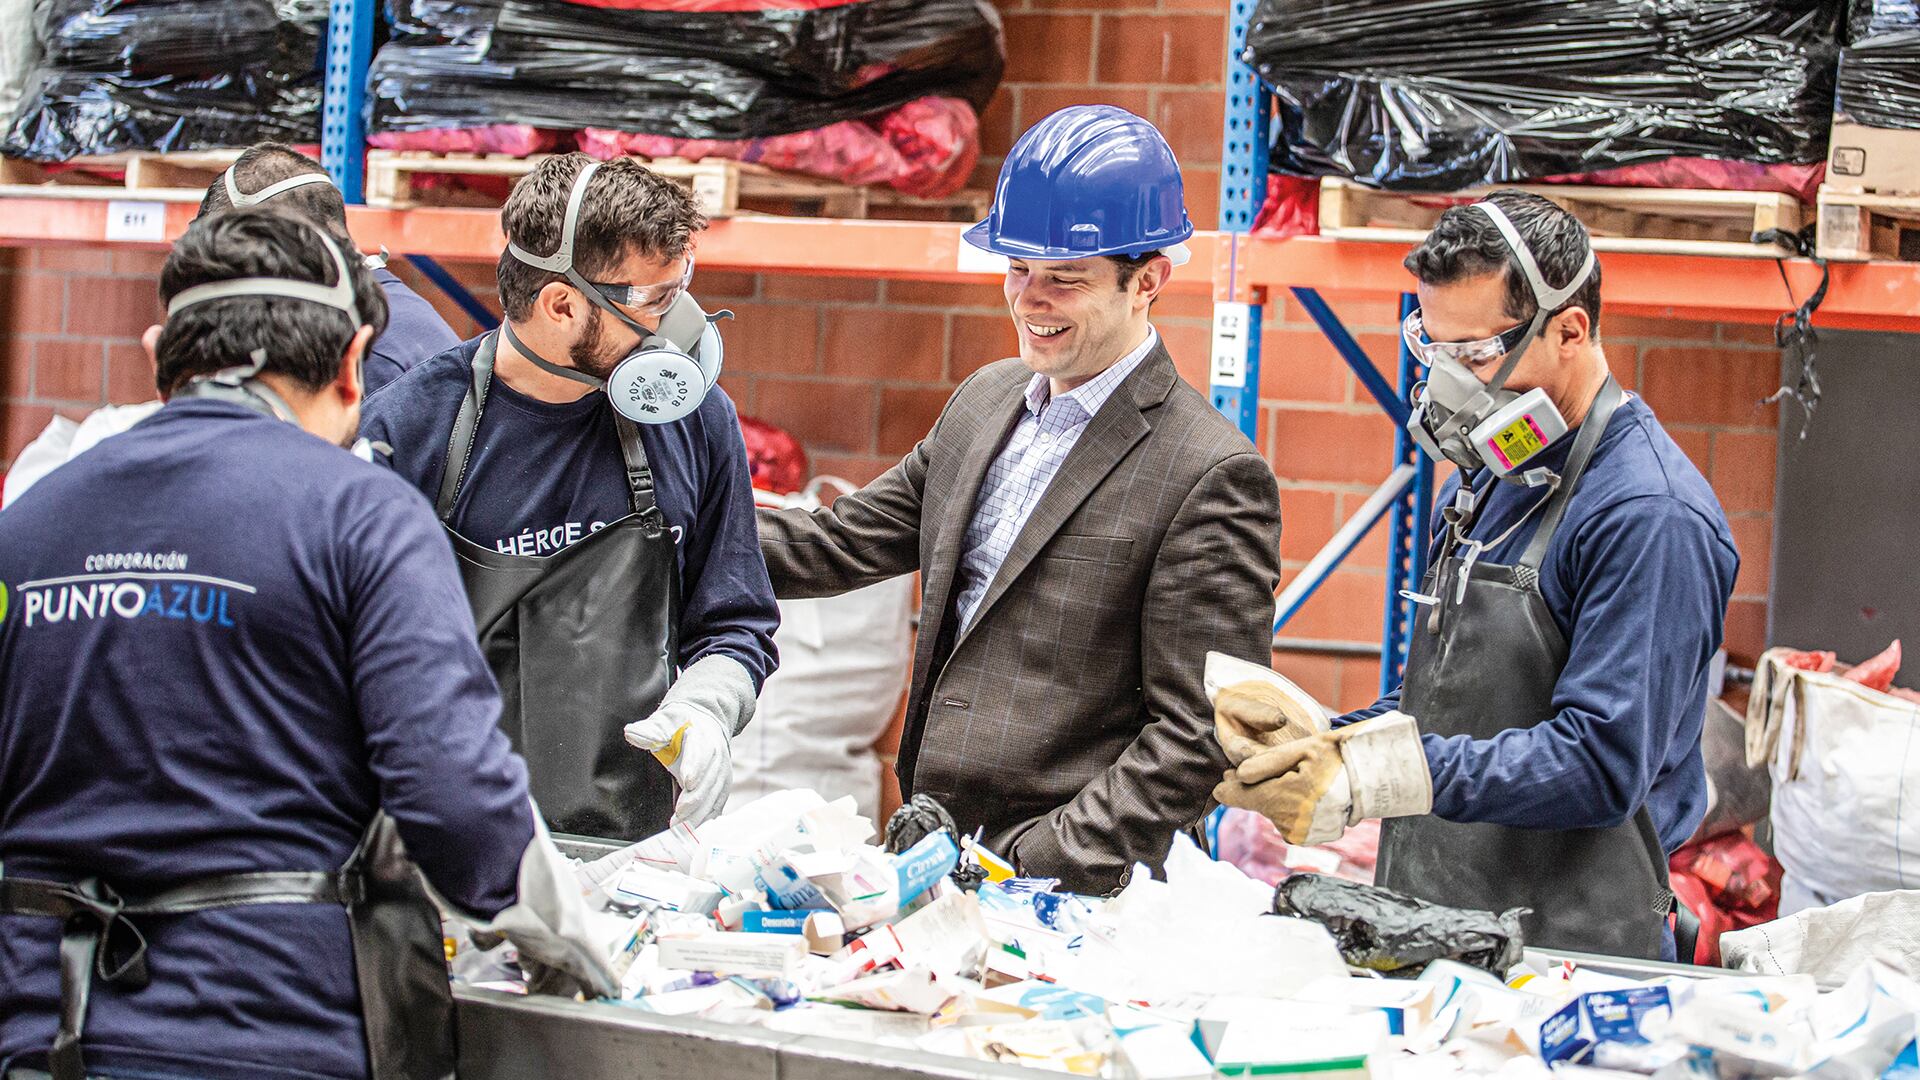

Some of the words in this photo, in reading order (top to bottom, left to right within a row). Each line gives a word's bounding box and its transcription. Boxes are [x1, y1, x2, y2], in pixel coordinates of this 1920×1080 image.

[660, 369, 678, 380] 3M
[629, 375, 646, 402] 2078
[671, 380, 688, 407] 2078
[640, 403, 660, 414] 3M
[496, 522, 582, 556] HÉROE
[85, 550, 188, 572] CORPORACIÓN
